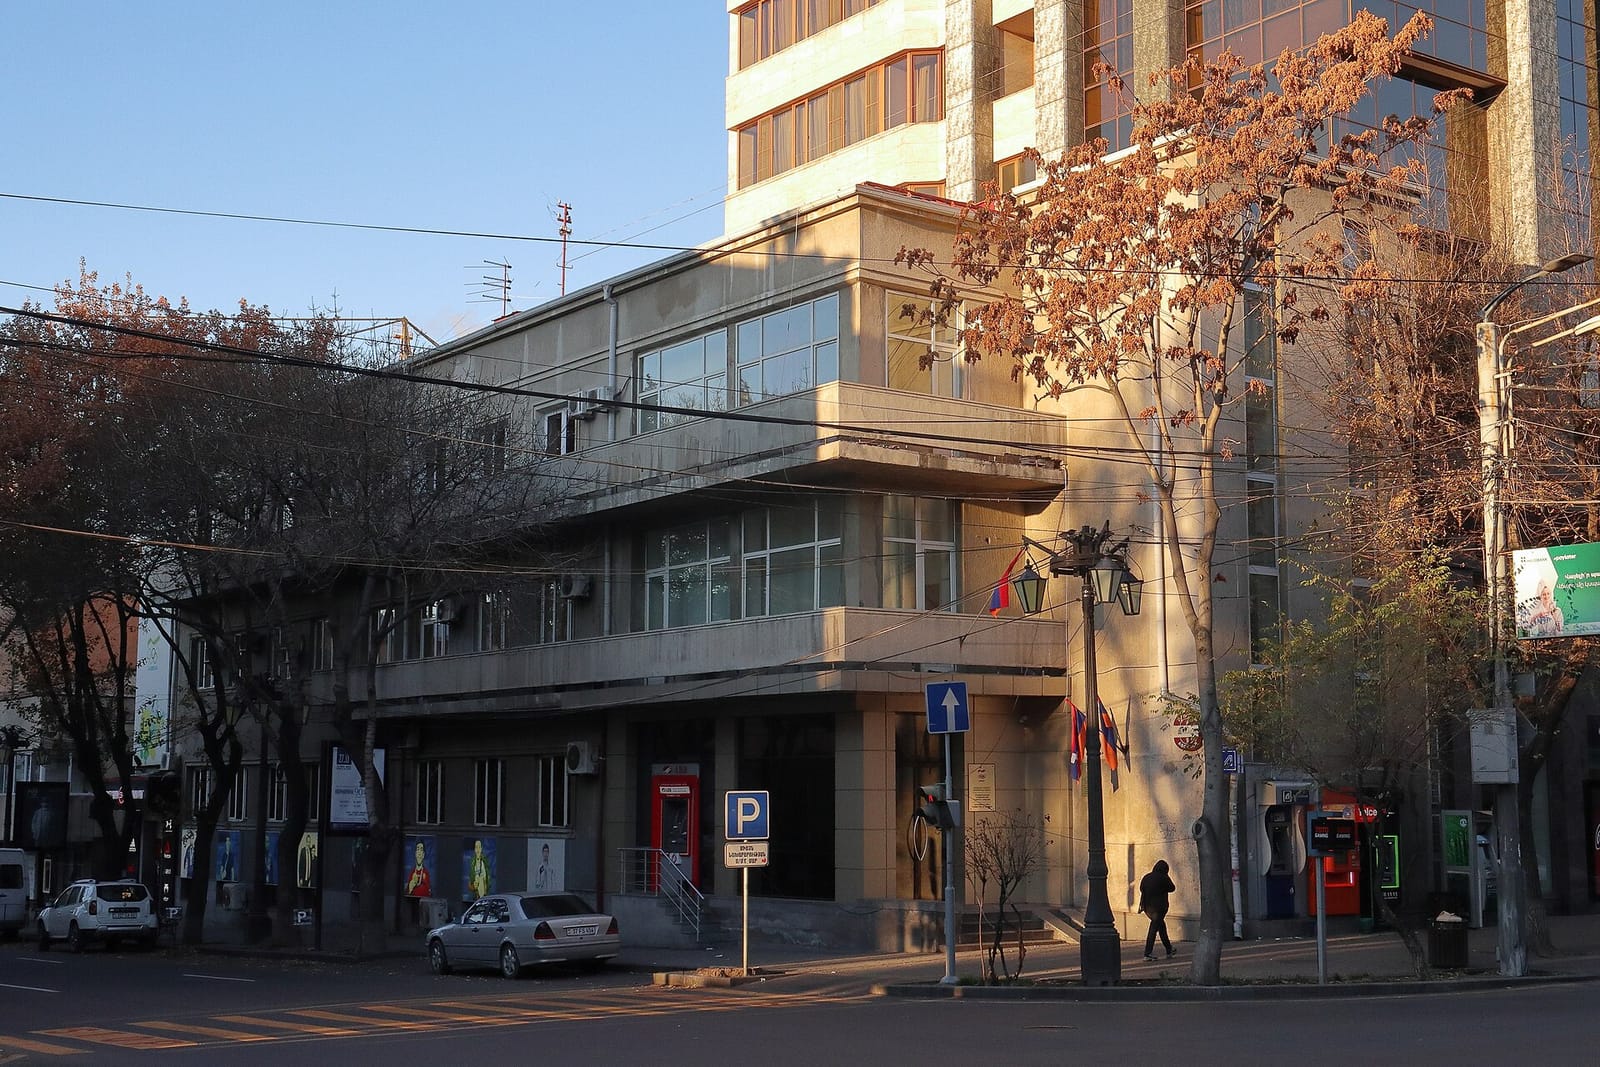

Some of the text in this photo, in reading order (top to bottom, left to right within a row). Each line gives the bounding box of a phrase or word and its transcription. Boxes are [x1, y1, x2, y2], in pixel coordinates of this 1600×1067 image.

[737, 798, 760, 834] P
[169, 907, 179, 919] P
[297, 911, 307, 923] P
